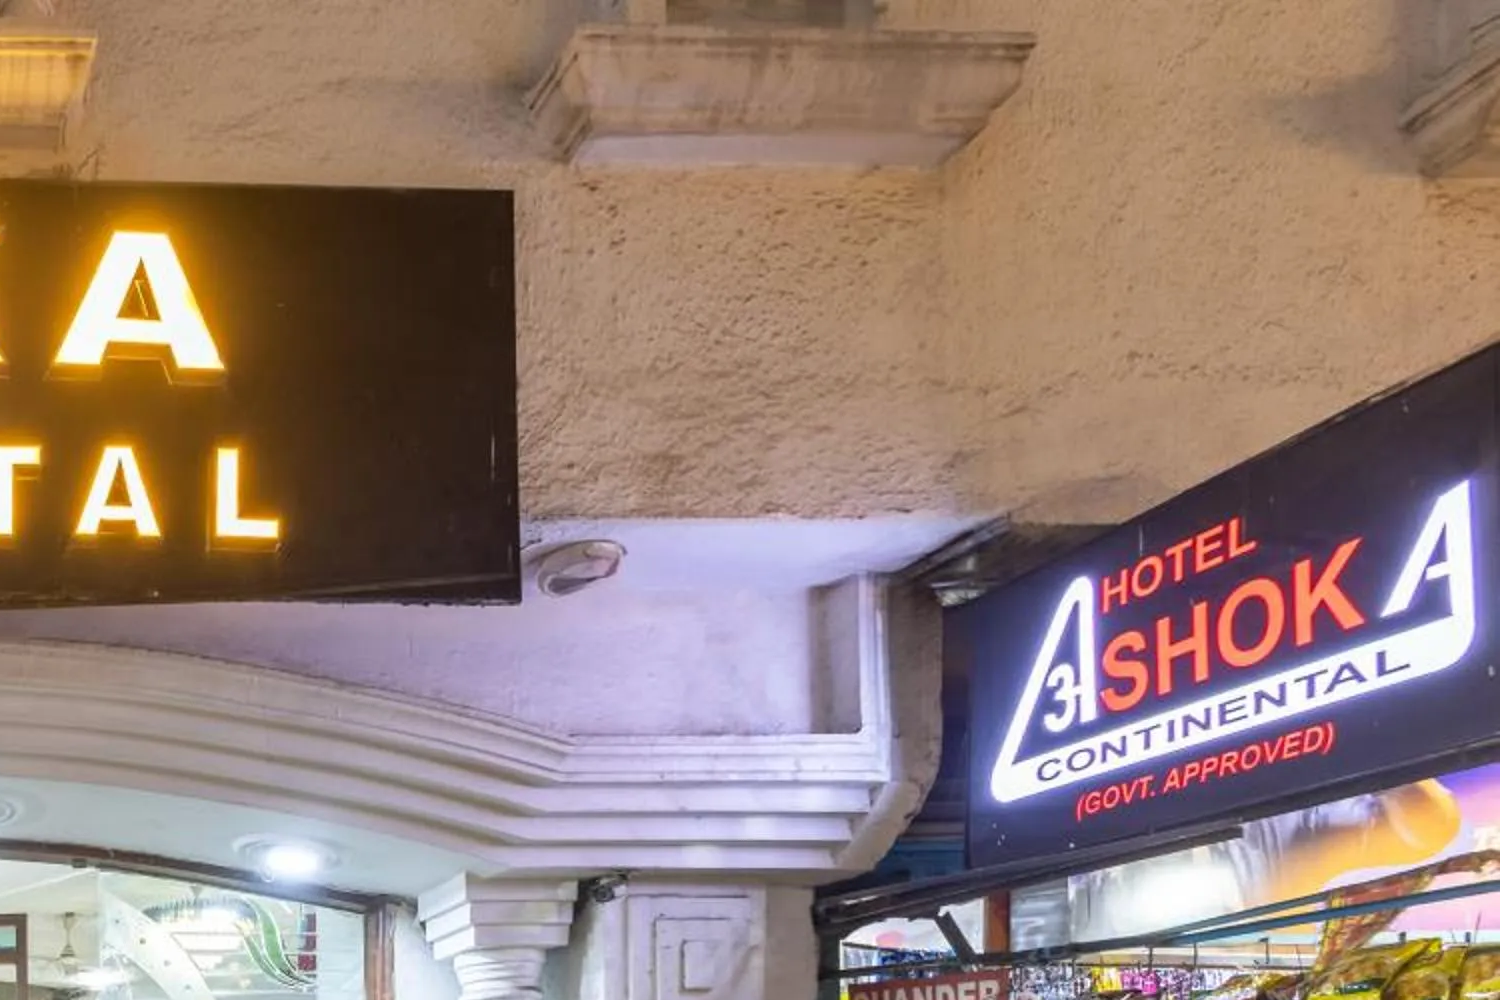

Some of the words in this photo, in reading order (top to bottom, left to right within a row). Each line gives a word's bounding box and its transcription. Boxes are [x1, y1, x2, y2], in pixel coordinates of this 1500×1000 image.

[1101, 515, 1258, 614] HOTEL
[996, 474, 1477, 785] ASHOKA
[1035, 649, 1411, 783] CONTINENTAL
[1075, 776, 1157, 822] (GOVT.
[1163, 721, 1338, 794] APPROVED)
